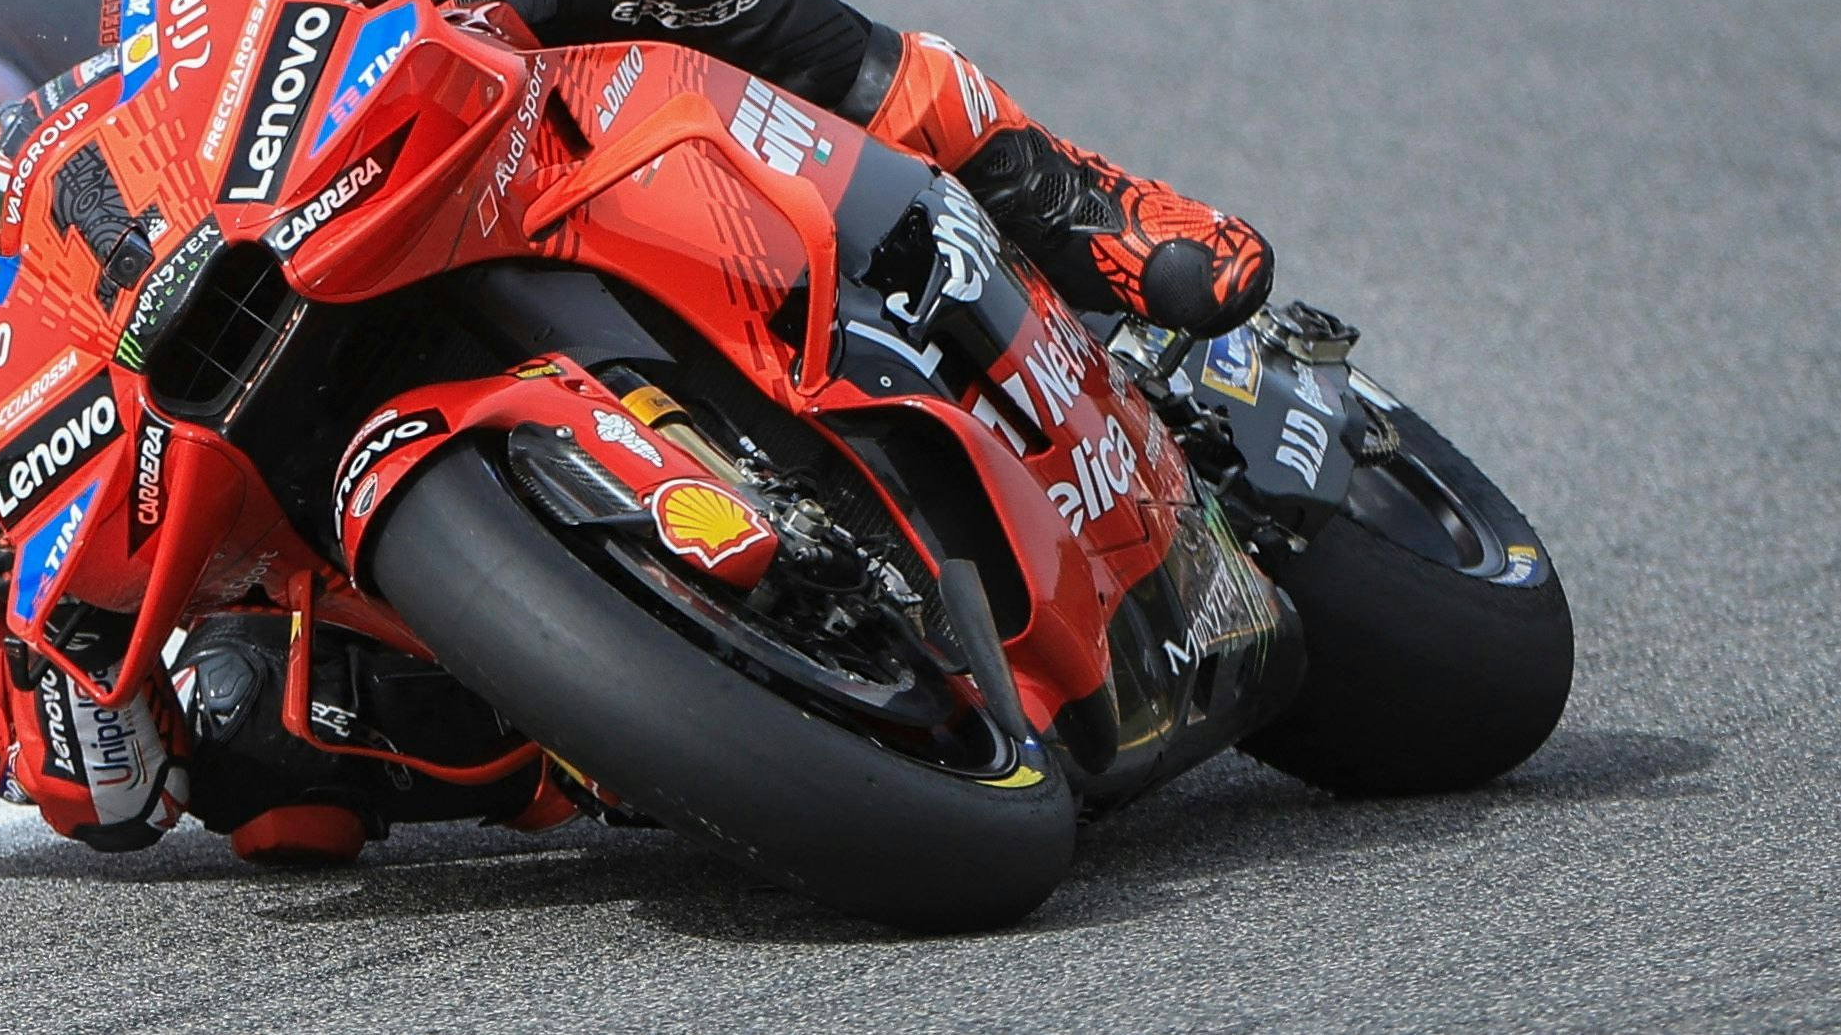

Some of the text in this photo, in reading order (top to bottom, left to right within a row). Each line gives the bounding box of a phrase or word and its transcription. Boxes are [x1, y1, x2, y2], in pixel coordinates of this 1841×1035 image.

[229, 6, 331, 201] Lenovo
[358, 30, 412, 87] TIM
[494, 54, 547, 197] Audi Sport
[274, 156, 383, 252] CARRERA
[129, 224, 220, 336] MONSTER
[1025, 298, 1099, 427] NetA
[137, 424, 165, 525] CARRERA
[335, 420, 429, 541] novo
[44, 503, 85, 572] TIM
